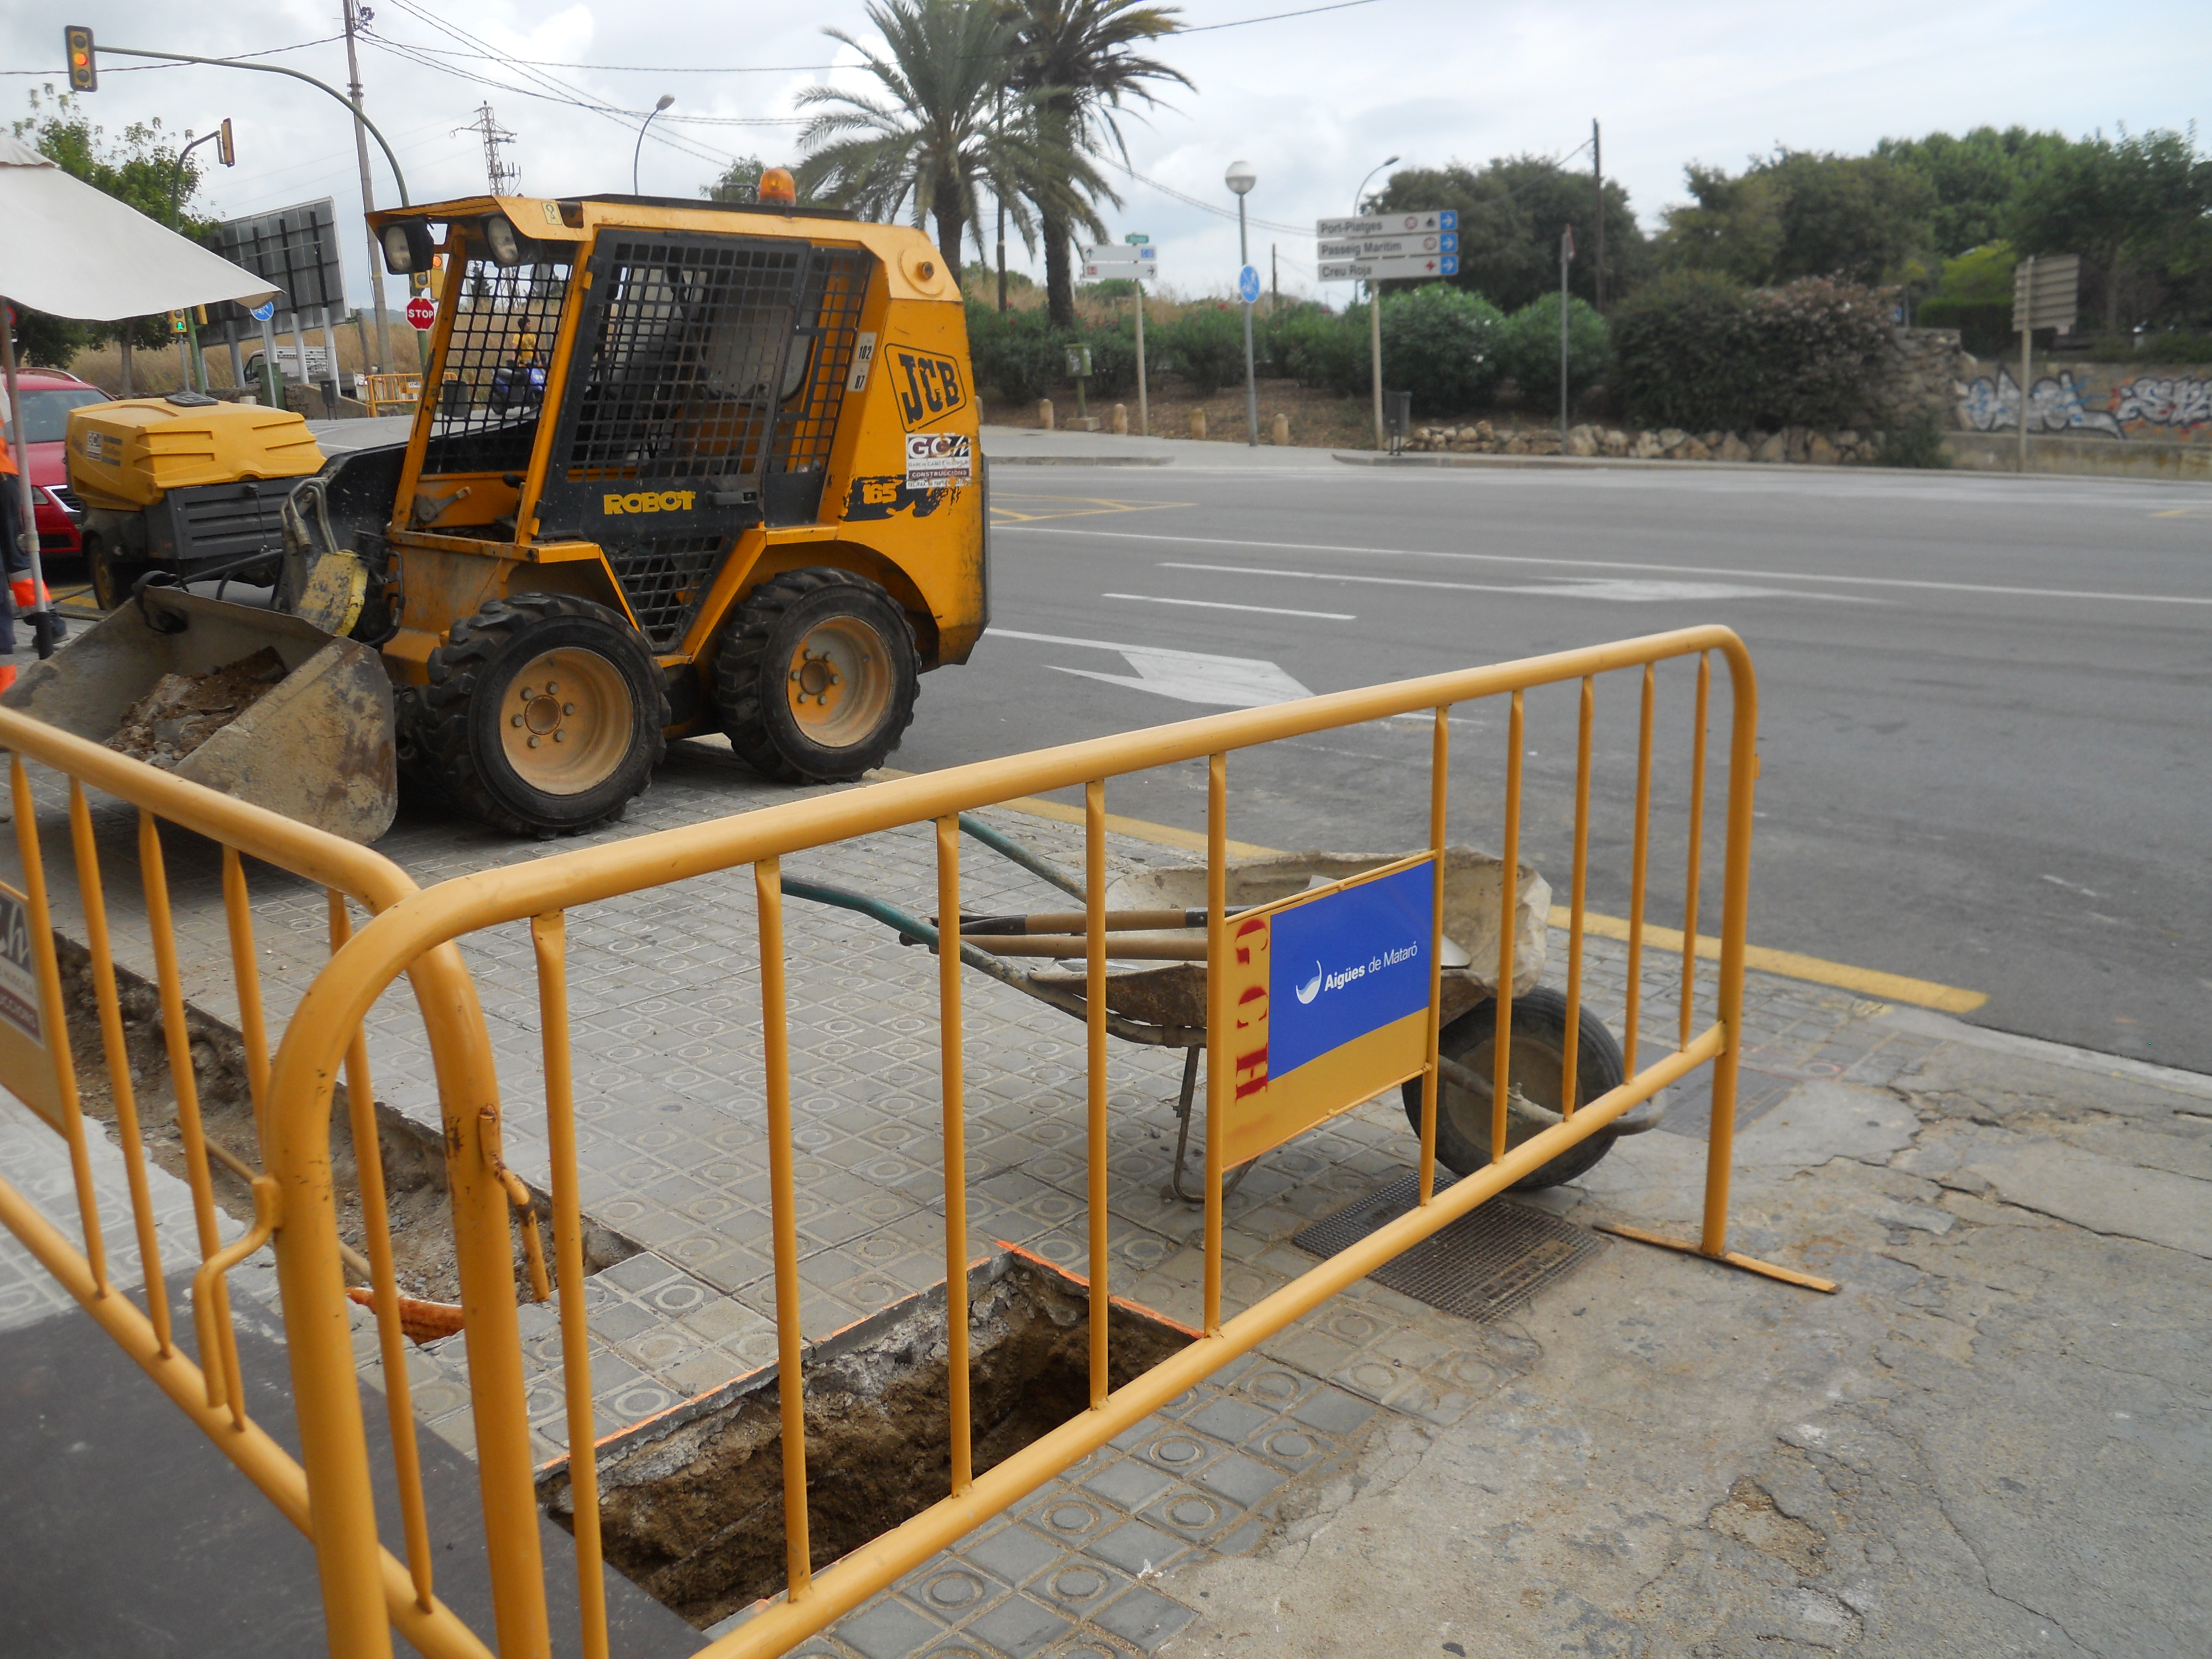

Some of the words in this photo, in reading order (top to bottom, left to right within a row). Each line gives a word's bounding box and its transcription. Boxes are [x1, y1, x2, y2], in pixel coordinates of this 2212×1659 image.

[1321, 243, 1361, 255] Passeig
[1322, 266, 1346, 277] Creu
[1349, 265, 1372, 276] Roja
[408, 309, 434, 319] STOP
[858, 345, 872, 359] 102
[854, 375, 865, 389] 87
[898, 352, 960, 424] JCB
[604, 490, 696, 514] ROBOT
[862, 483, 897, 504] 165
[1324, 965, 1365, 991] Aigües
[1369, 956, 1381, 973] de
[1384, 941, 1418, 967] Mataró
[1235, 918, 1268, 1106] GCH
